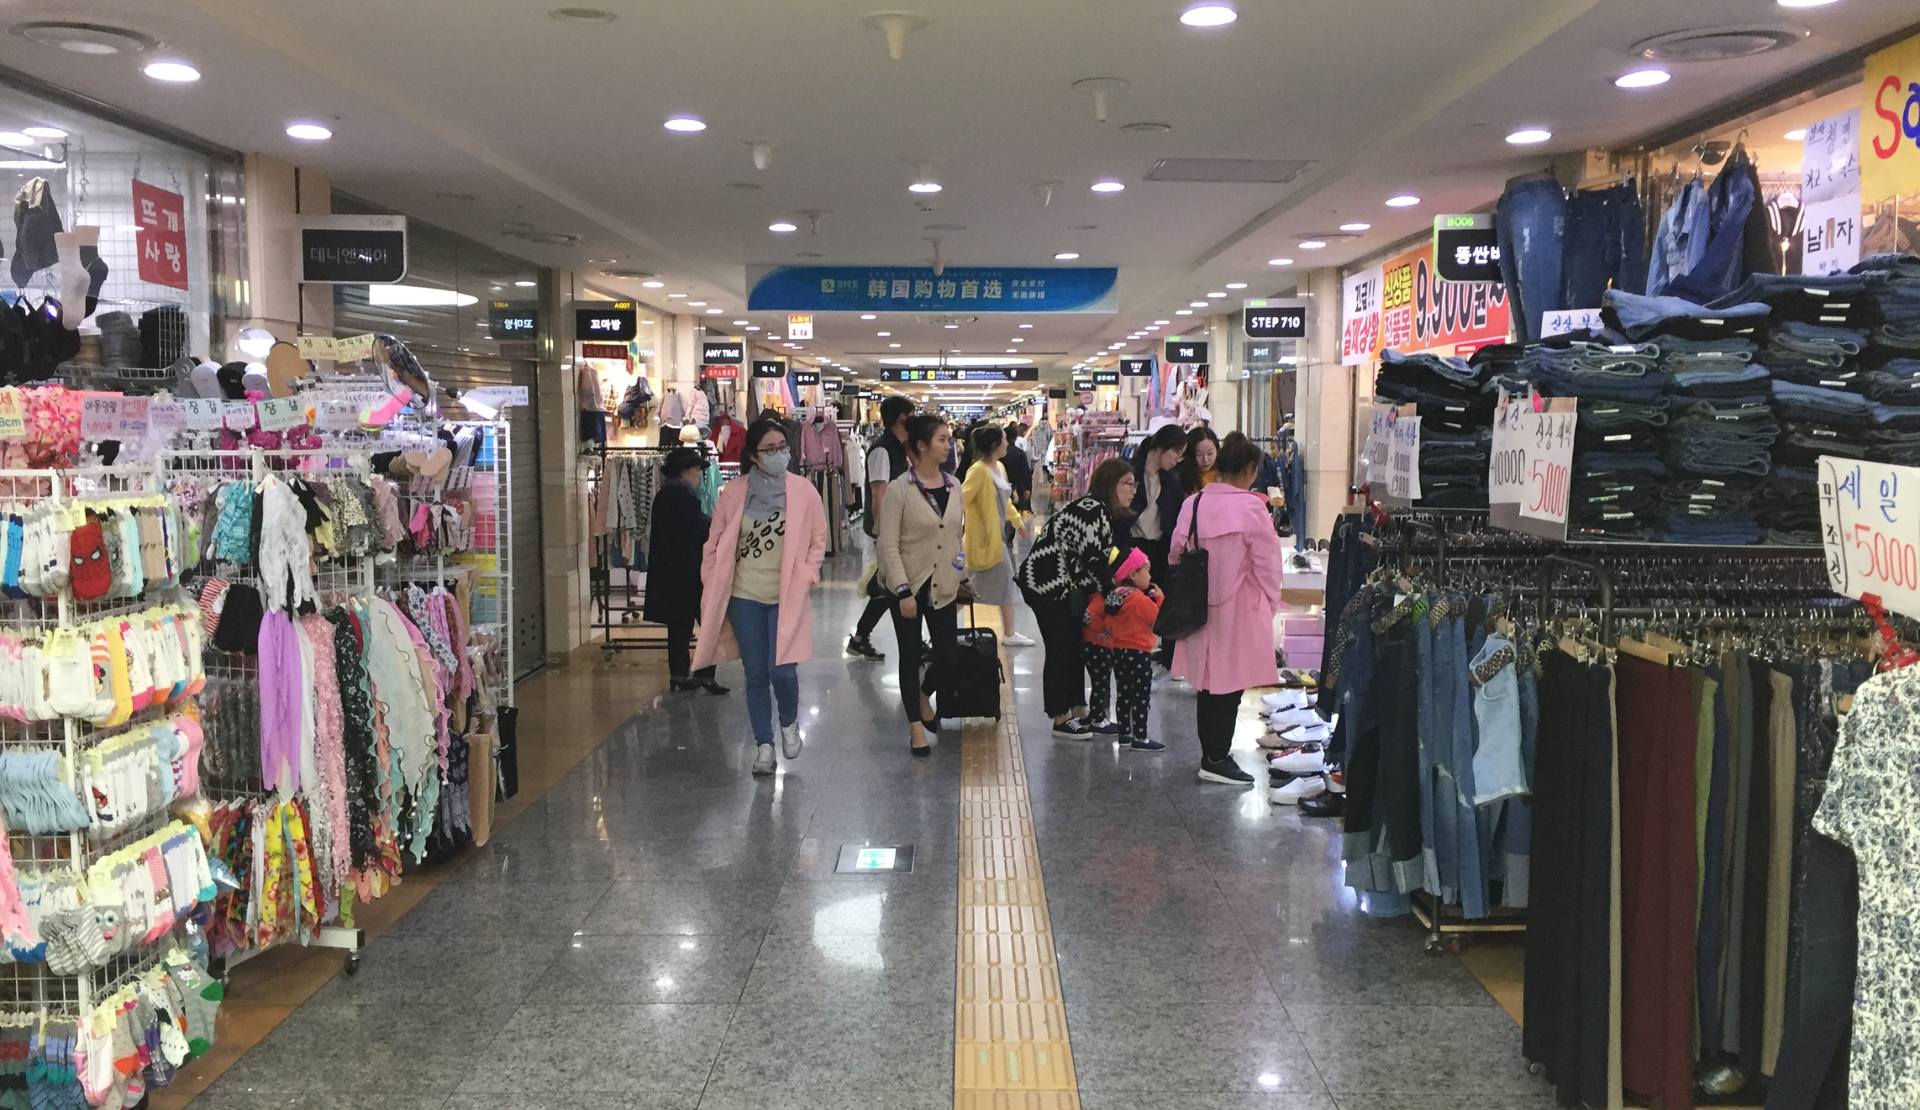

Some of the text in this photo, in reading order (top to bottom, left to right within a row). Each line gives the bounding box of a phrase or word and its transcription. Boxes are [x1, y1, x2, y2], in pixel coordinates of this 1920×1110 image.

[141, 199, 179, 233] 뜨개
[1447, 217, 1474, 226] B005
[145, 239, 182, 273] 사랑
[309, 247, 388, 264] 데니엔제이
[867, 279, 1002, 299] 韩国购物首选
[1384, 262, 1412, 309] 신상품
[1251, 317, 1300, 328] STEP 710
[1384, 308, 1411, 348] 전품목
[705, 349, 740, 358] ANY TIME
[1179, 348, 1194, 357] THE
[328, 405, 356, 414] 스카프
